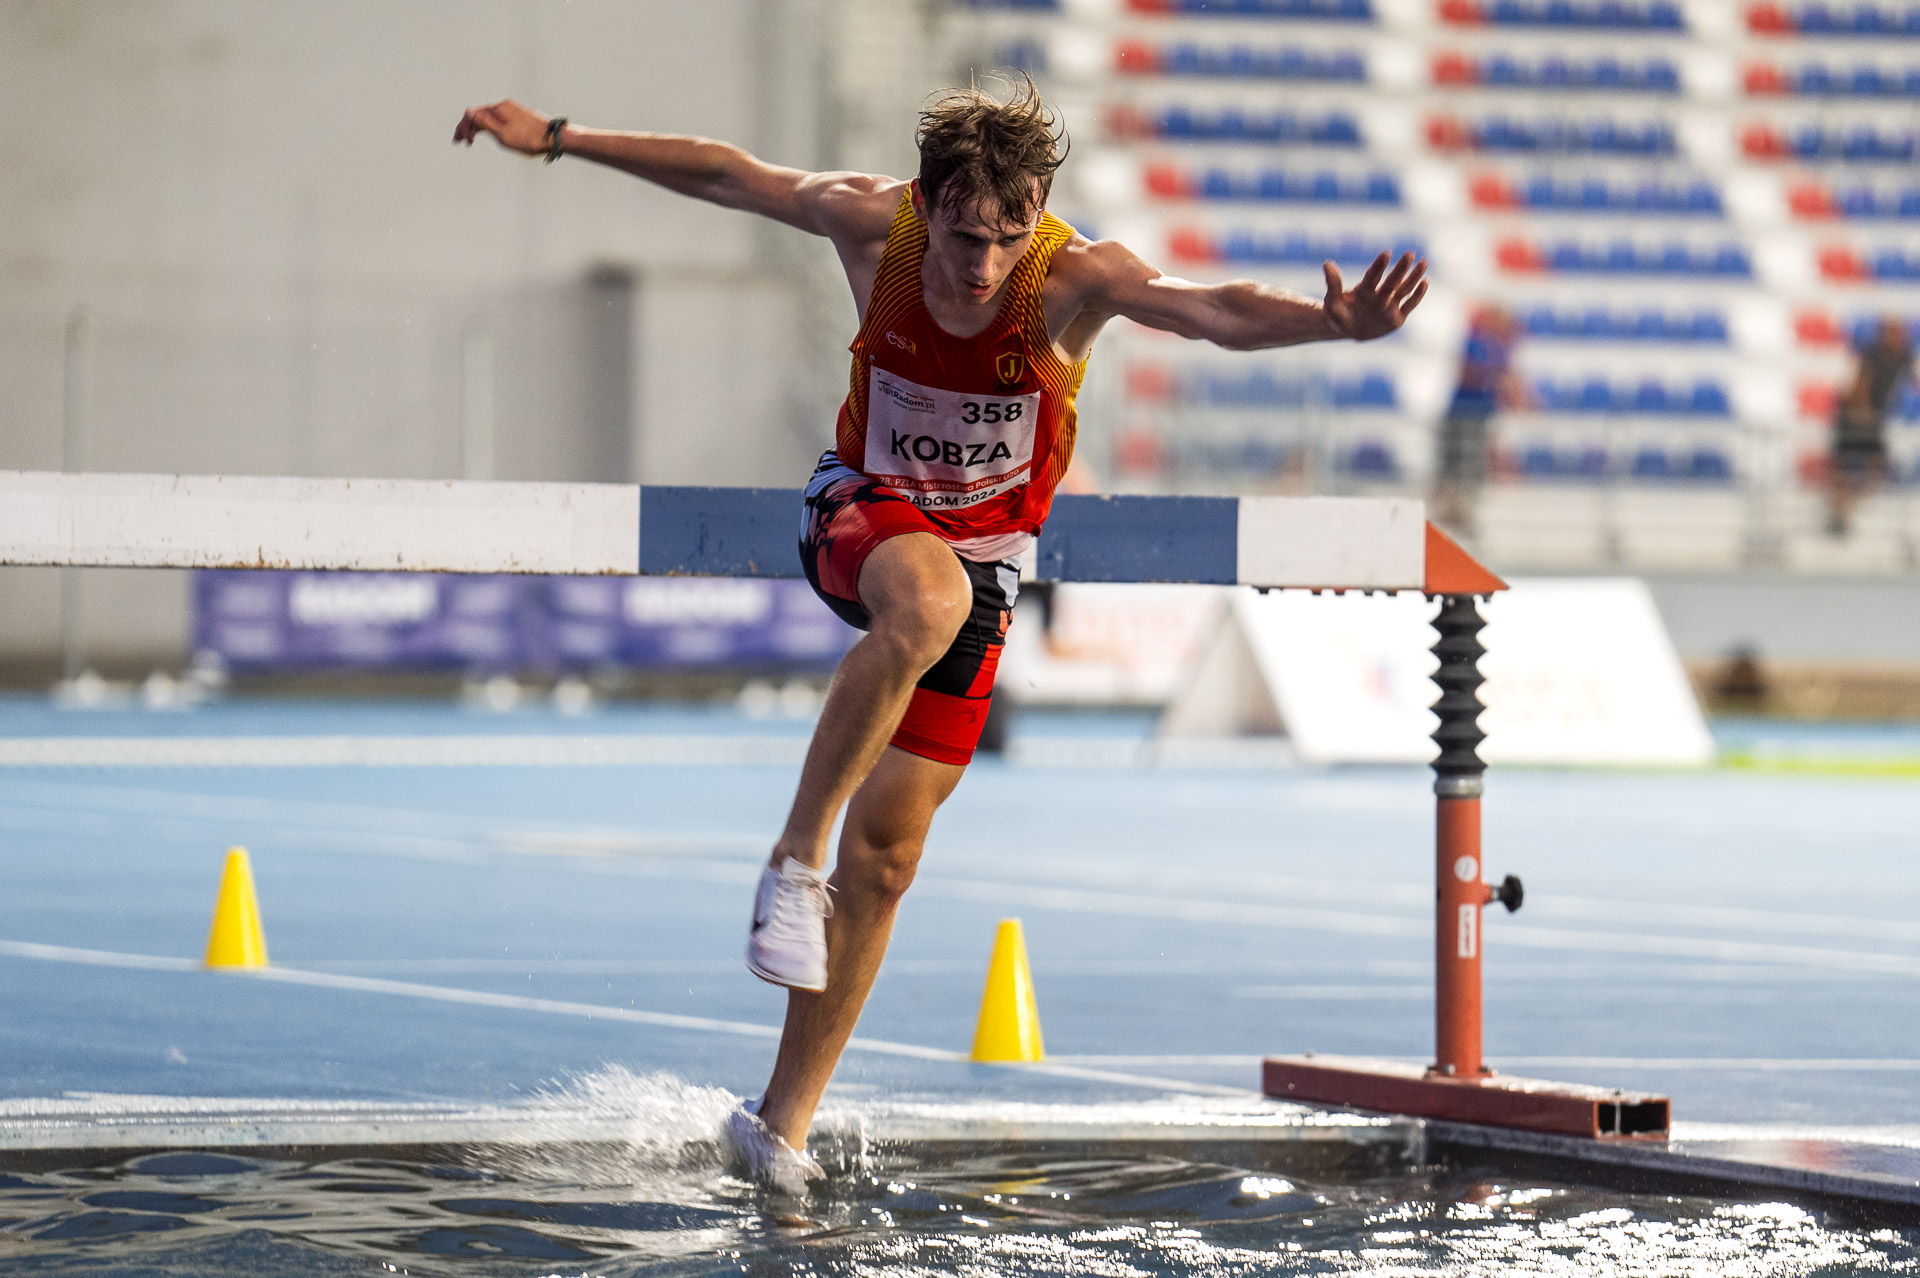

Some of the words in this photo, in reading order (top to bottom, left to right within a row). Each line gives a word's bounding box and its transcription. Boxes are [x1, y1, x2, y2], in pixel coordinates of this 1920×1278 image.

[1004, 359, 1015, 378] J
[877, 385, 935, 409] visitRadom.pl
[961, 402, 1023, 424] 358
[891, 429, 1012, 468] KOBZA
[879, 476, 893, 486] 78.
[894, 478, 915, 488] PZLA
[918, 481, 974, 491] Mistrzostwa
[975, 476, 1002, 488] Polski
[962, 488, 997, 506] 2024
